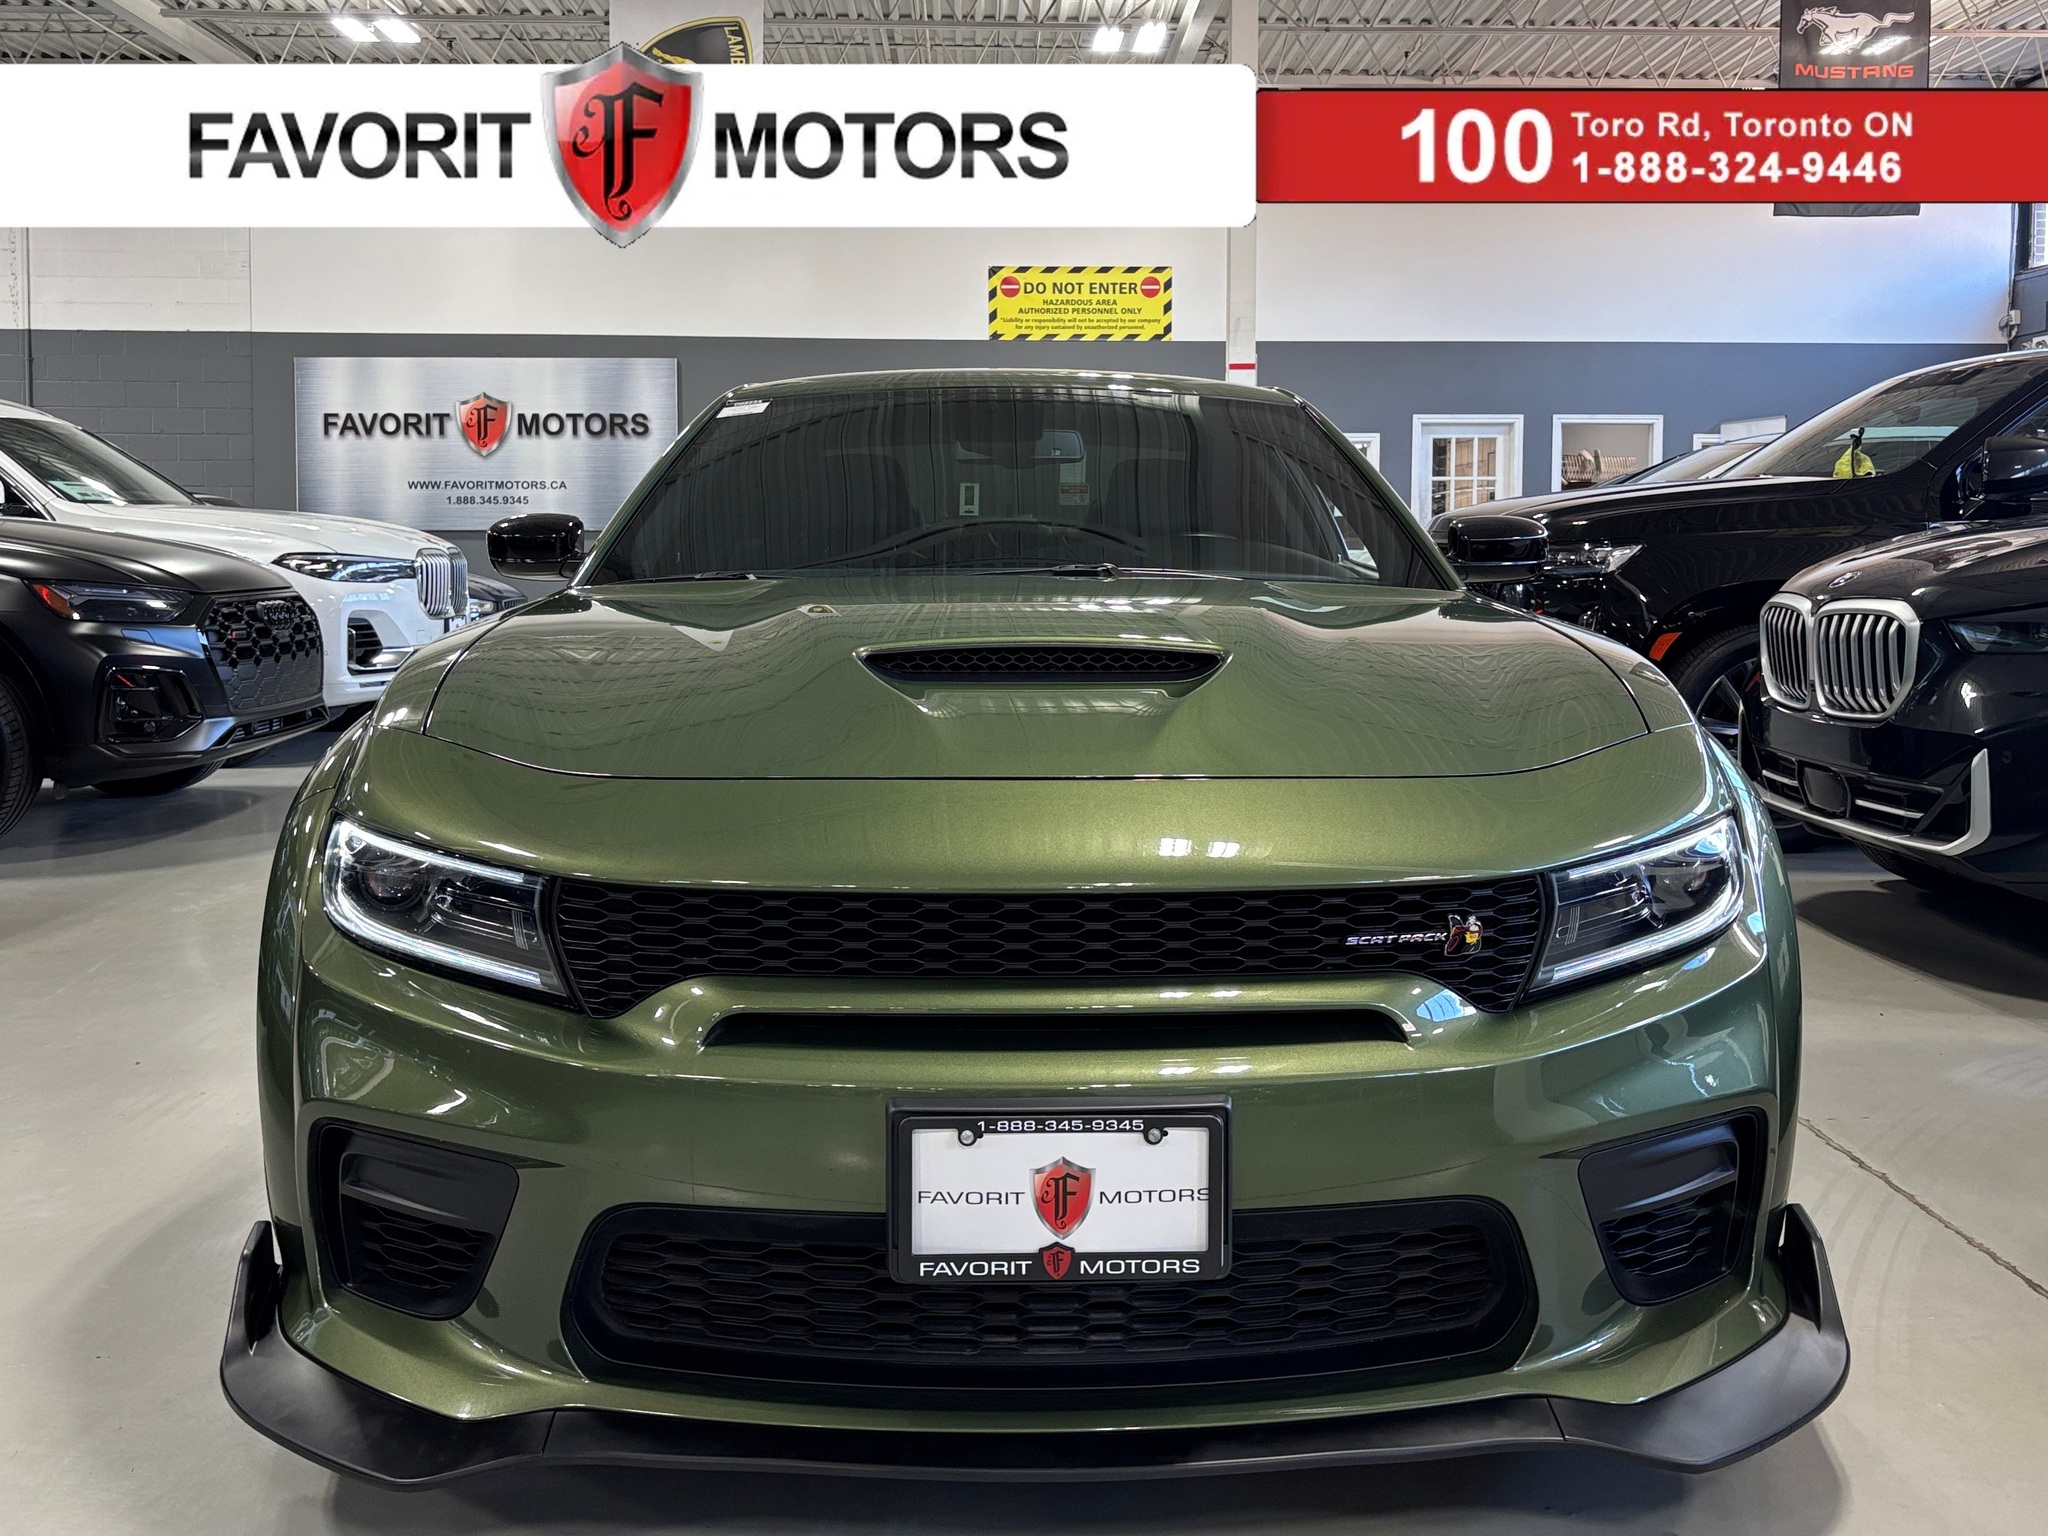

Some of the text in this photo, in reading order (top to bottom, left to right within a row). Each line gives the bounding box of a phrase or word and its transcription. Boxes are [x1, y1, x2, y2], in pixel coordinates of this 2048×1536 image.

[1795, 63, 1914, 80] MUSTANG
[1024, 282, 1138, 294] DO NOT ENTER
[1018, 307, 1142, 315] AUTHORIZED PERSONNEL ONLY
[323, 412, 450, 436] FAVORIT
[517, 412, 650, 436] MOTORS
[407, 480, 567, 491] WWW.FAVORITMOTORS.CA
[446, 496, 529, 506] 1.888.345.9345
[1345, 932, 1448, 946] SCAT PACK
[977, 1119, 1144, 1132] 1-888-345-9345
[918, 1190, 1025, 1205] FAVORIT
[1099, 1187, 1209, 1204] MOTORS
[919, 1261, 1033, 1277] FAVORIT
[1079, 1258, 1201, 1275] MOTORS
